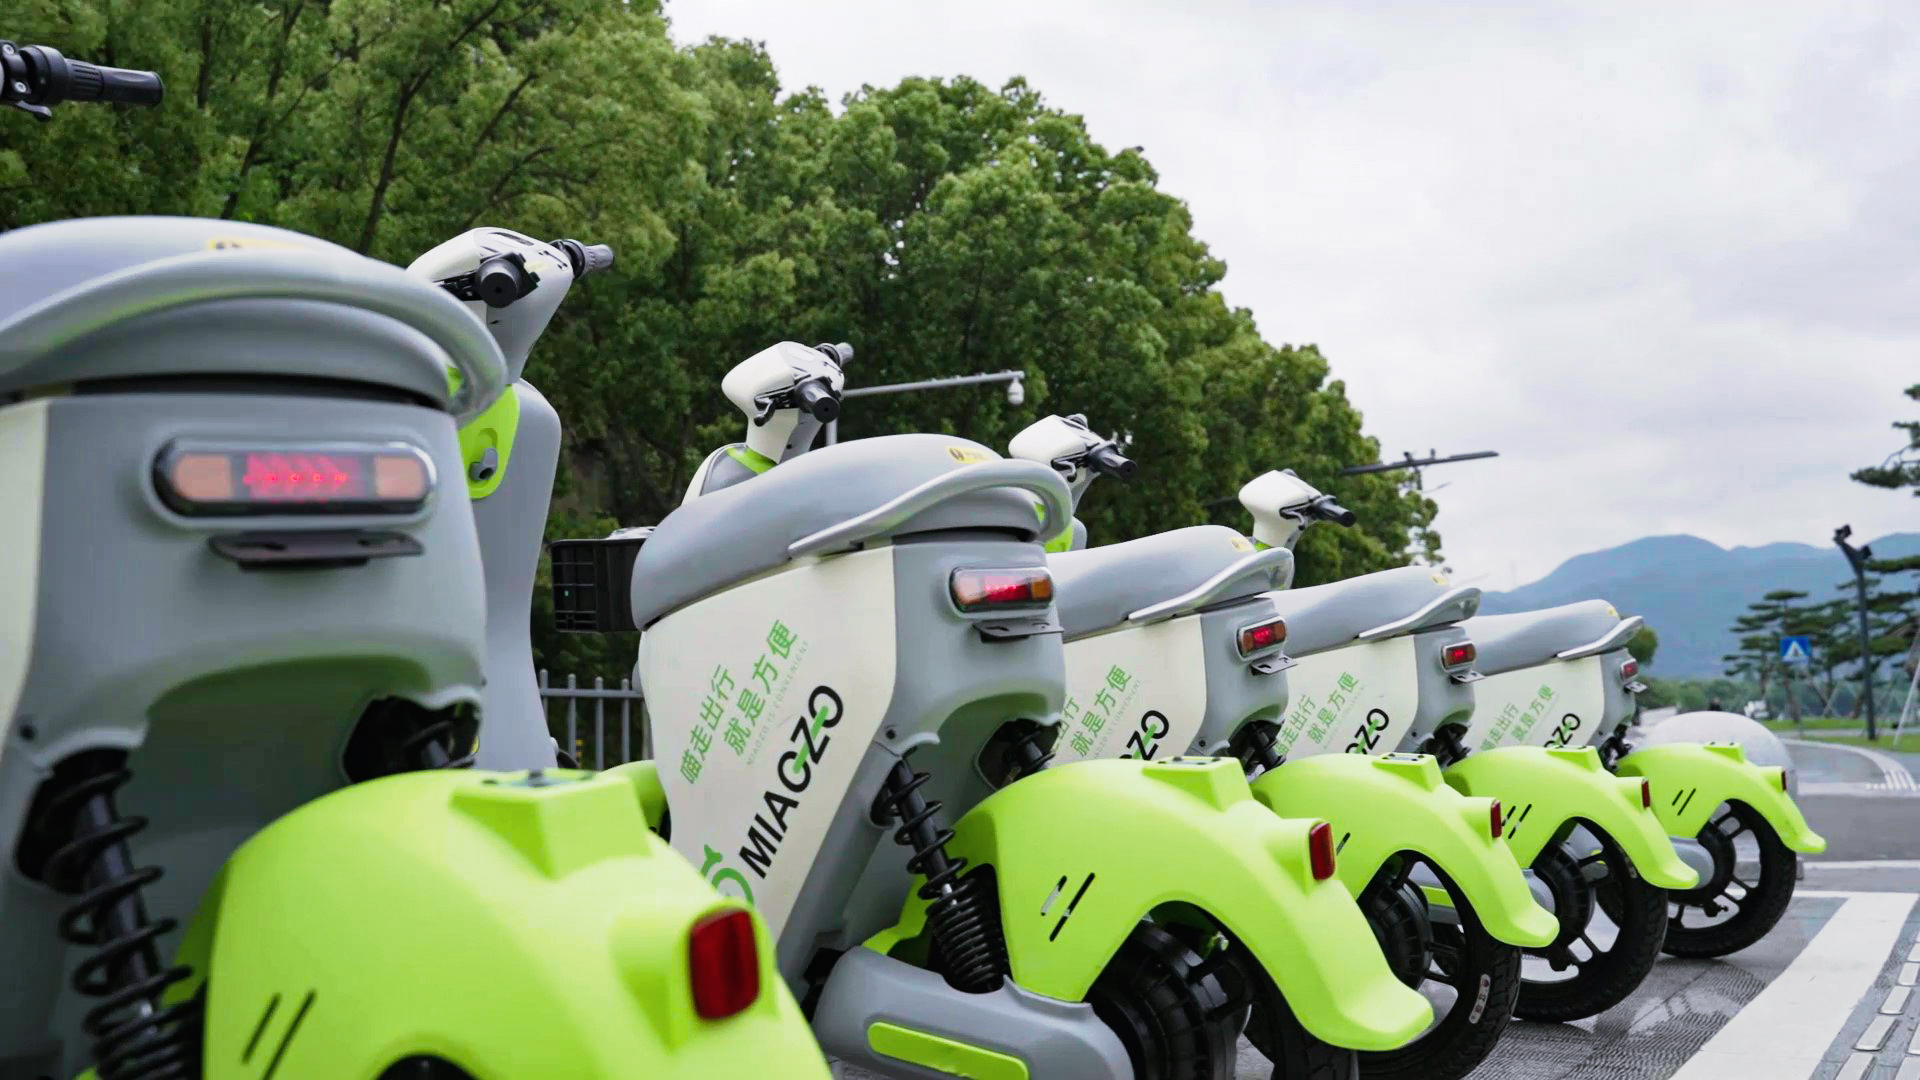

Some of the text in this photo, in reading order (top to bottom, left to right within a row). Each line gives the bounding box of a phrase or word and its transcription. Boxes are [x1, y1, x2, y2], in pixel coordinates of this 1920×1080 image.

[680, 664, 736, 784] 喵走出行
[723, 619, 798, 757] 就是方便
[1070, 664, 1132, 757] 就是方便
[1307, 671, 1359, 744] 就是方便
